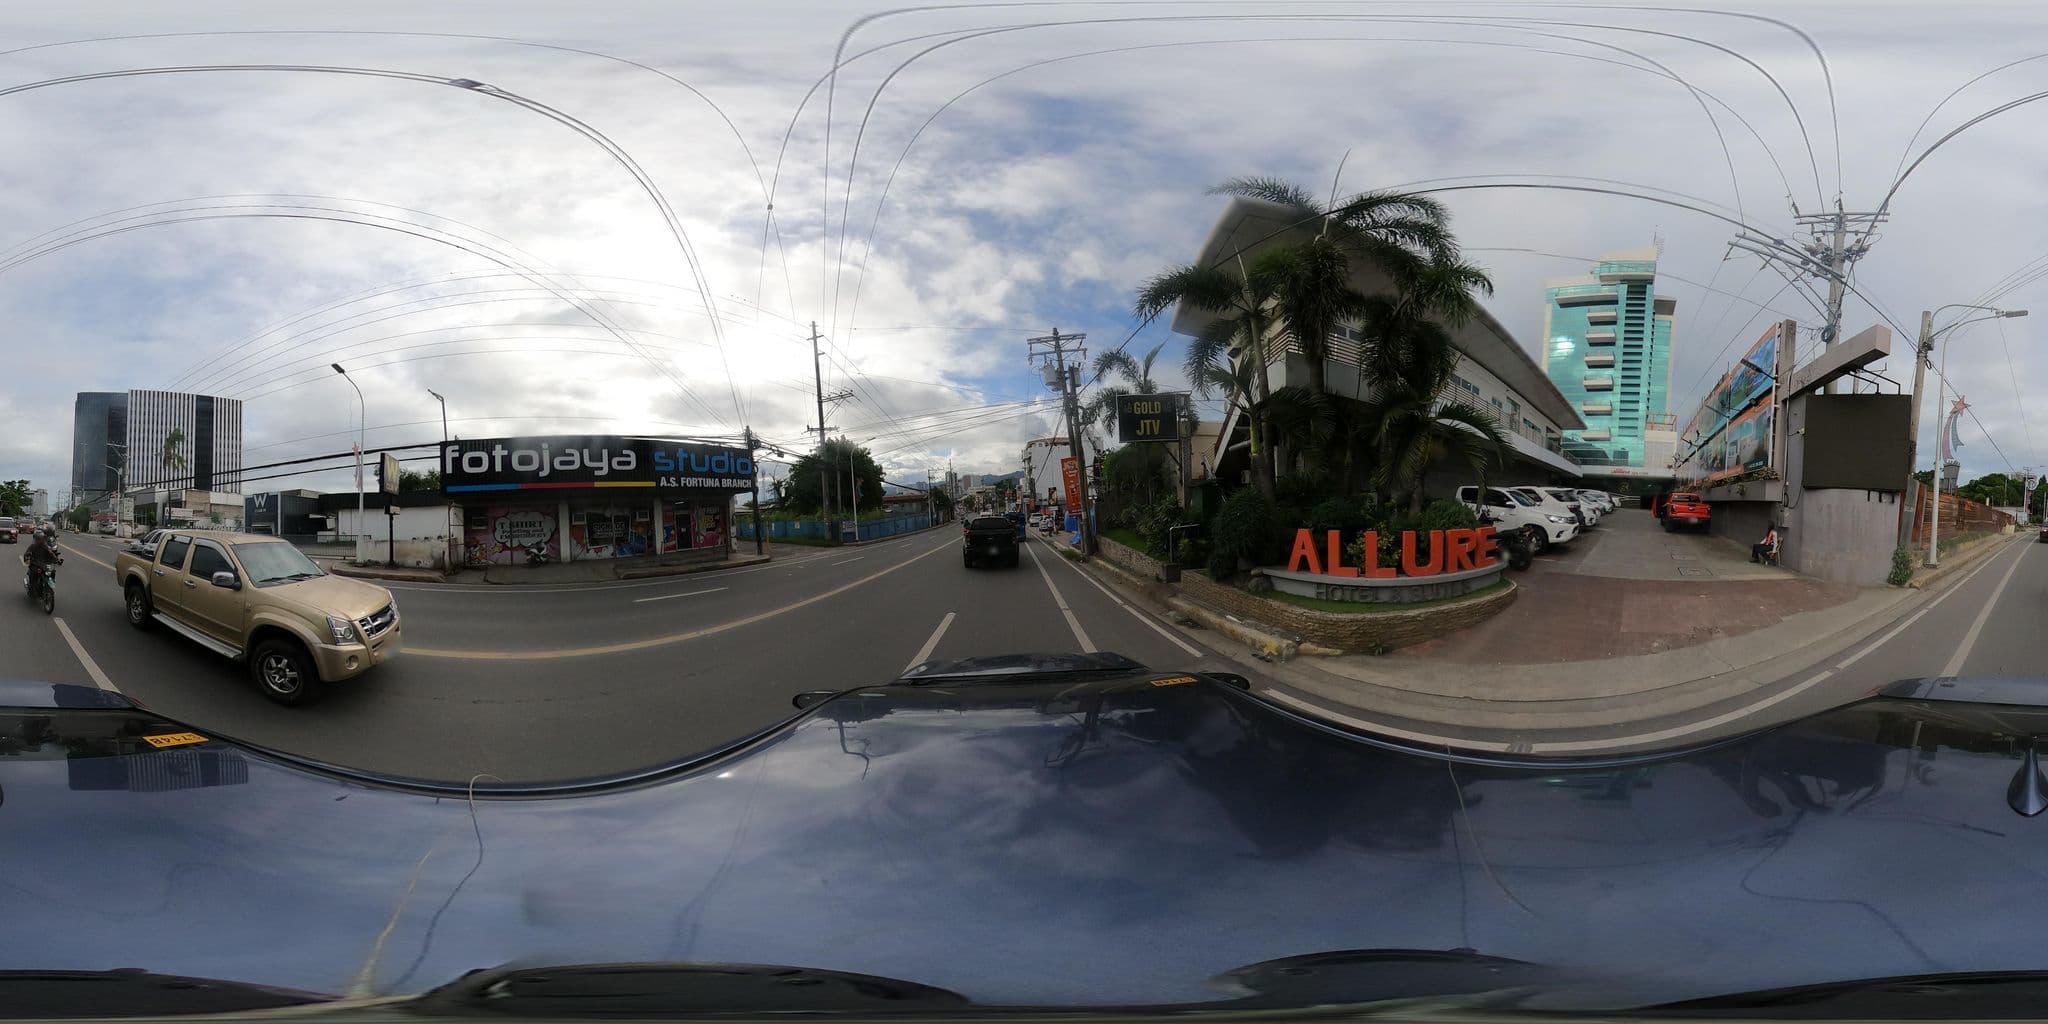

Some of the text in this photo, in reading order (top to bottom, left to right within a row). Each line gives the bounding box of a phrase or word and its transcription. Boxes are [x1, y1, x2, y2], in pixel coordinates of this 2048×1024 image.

[1134, 401, 1161, 414] GOLD
[1136, 420, 1160, 436] JTV
[445, 443, 753, 477] fotojaya studio
[660, 476, 752, 489] A.S. FORTUNA BRANCH
[254, 494, 268, 508] W
[1287, 526, 1498, 579] ALLURE
